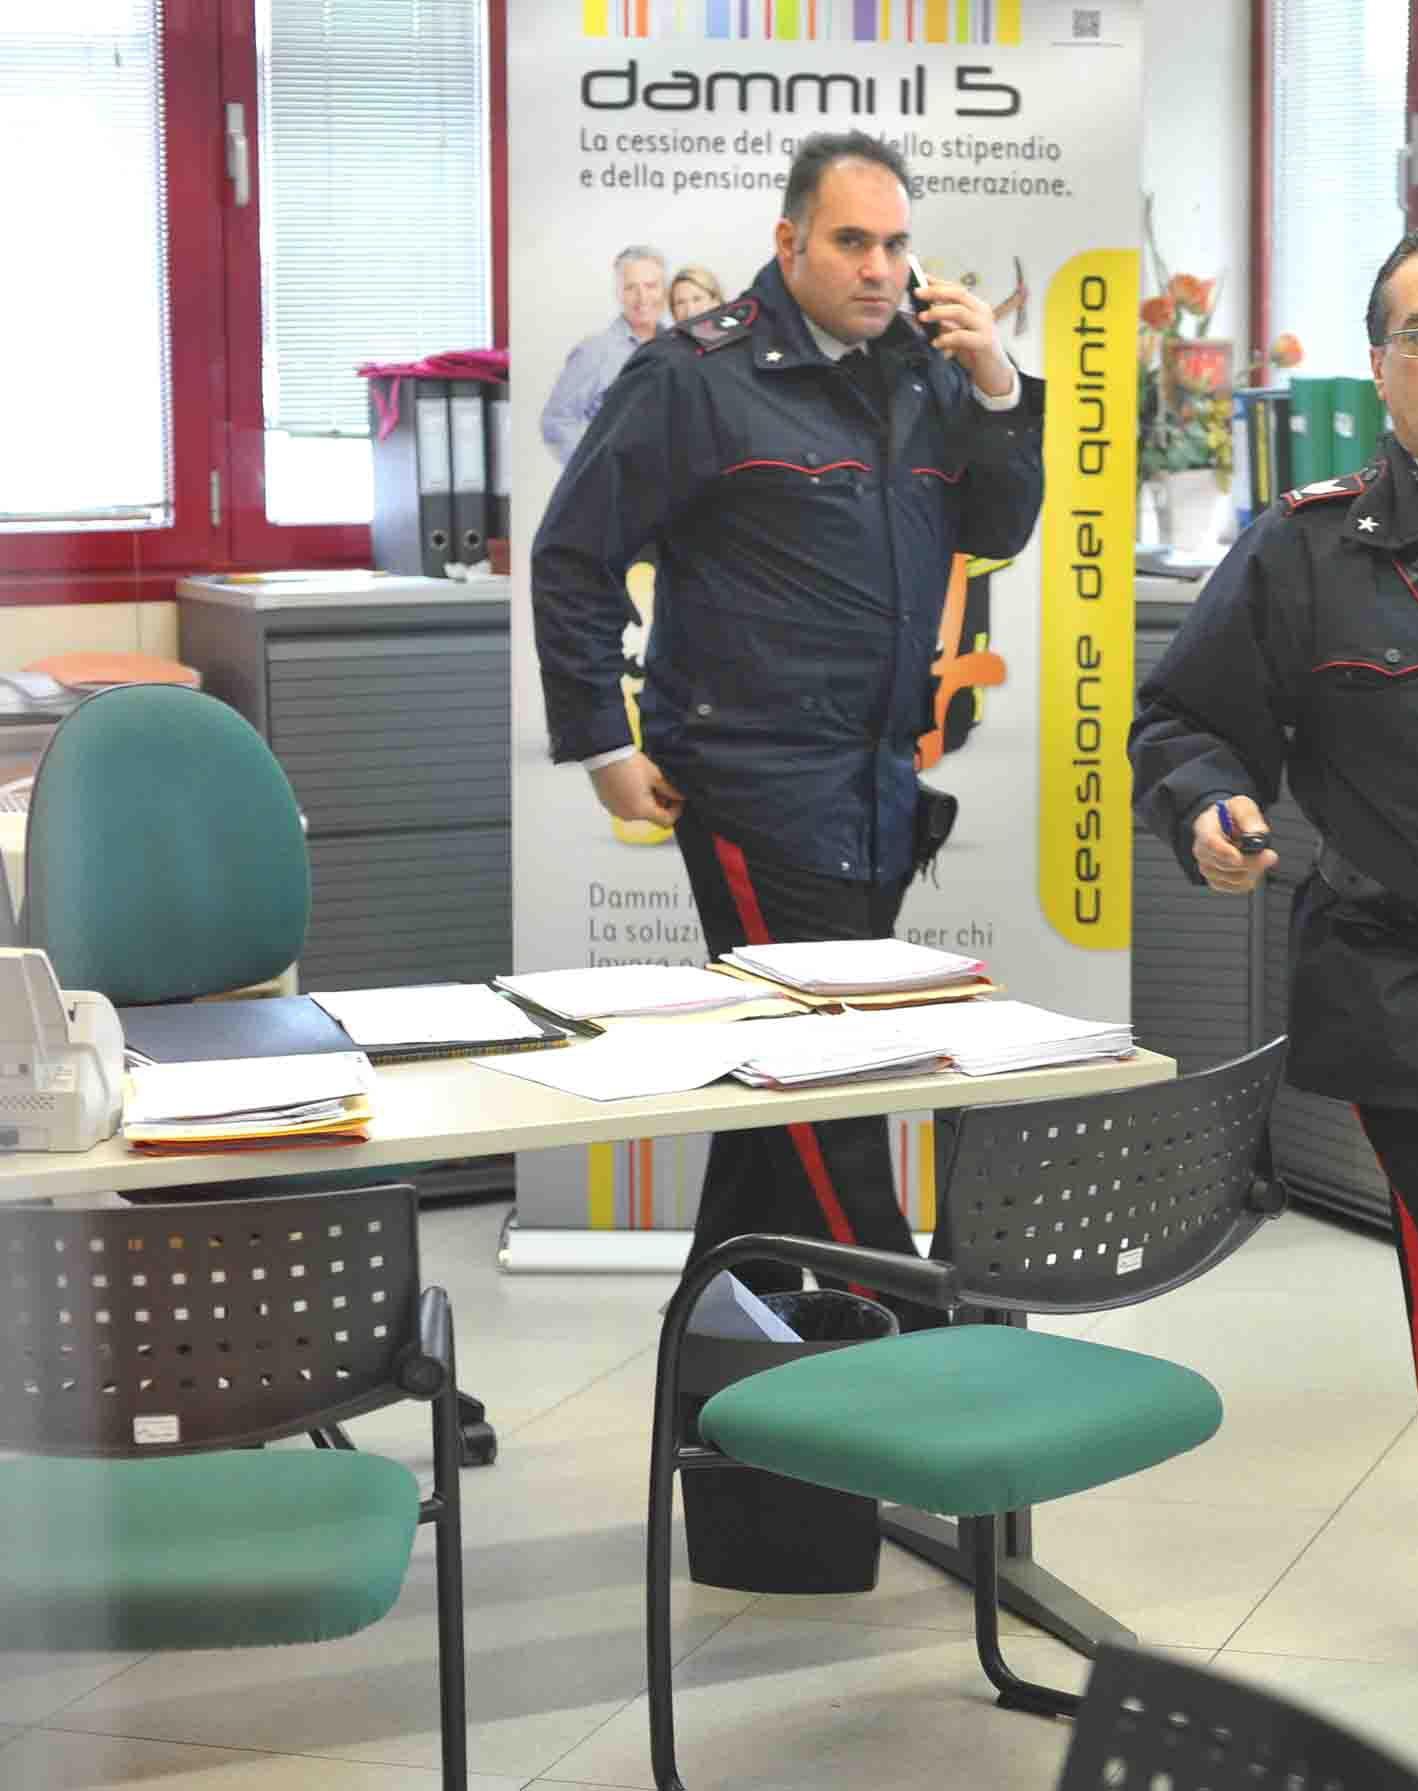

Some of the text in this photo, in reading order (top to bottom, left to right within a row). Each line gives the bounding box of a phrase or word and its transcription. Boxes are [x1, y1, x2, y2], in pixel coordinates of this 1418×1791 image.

[581, 60, 1021, 117] dammi il 5
[579, 126, 608, 152] La
[616, 129, 727, 153] cessione
[733, 129, 772, 154] del
[941, 133, 1062, 165] stipendio
[580, 162, 1073, 200] e della pensione generazione.
[1070, 275, 1111, 925] cessione del quinto
[589, 882, 679, 908] Dammi
[589, 918, 993, 946] La soluzi per chi
